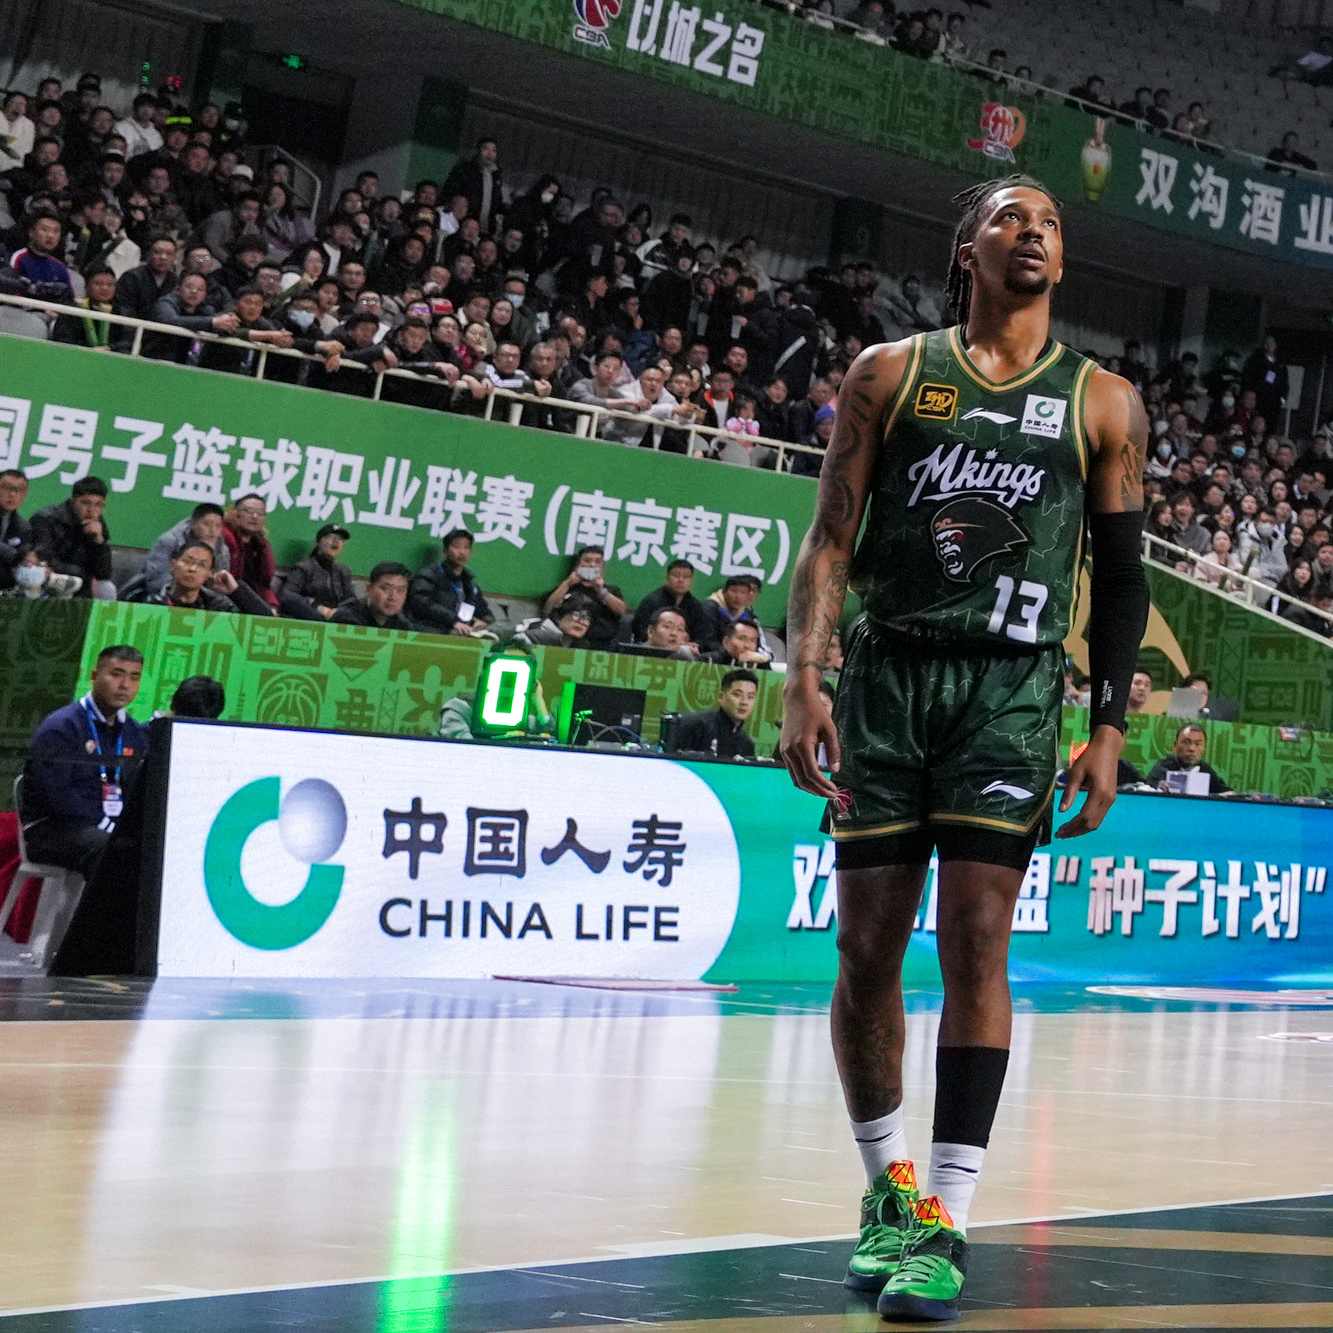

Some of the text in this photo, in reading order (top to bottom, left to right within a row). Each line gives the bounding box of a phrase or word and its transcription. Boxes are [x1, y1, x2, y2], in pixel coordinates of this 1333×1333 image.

[1024, 425, 1044, 433] CHINA
[1025, 418, 1059, 429] 中国人寿
[906, 443, 1046, 509] Mkings
[986, 574, 1050, 645] 13
[480, 657, 532, 727] 0
[381, 796, 688, 887] 中国人寿
[378, 897, 682, 944] CHINA LIFE
